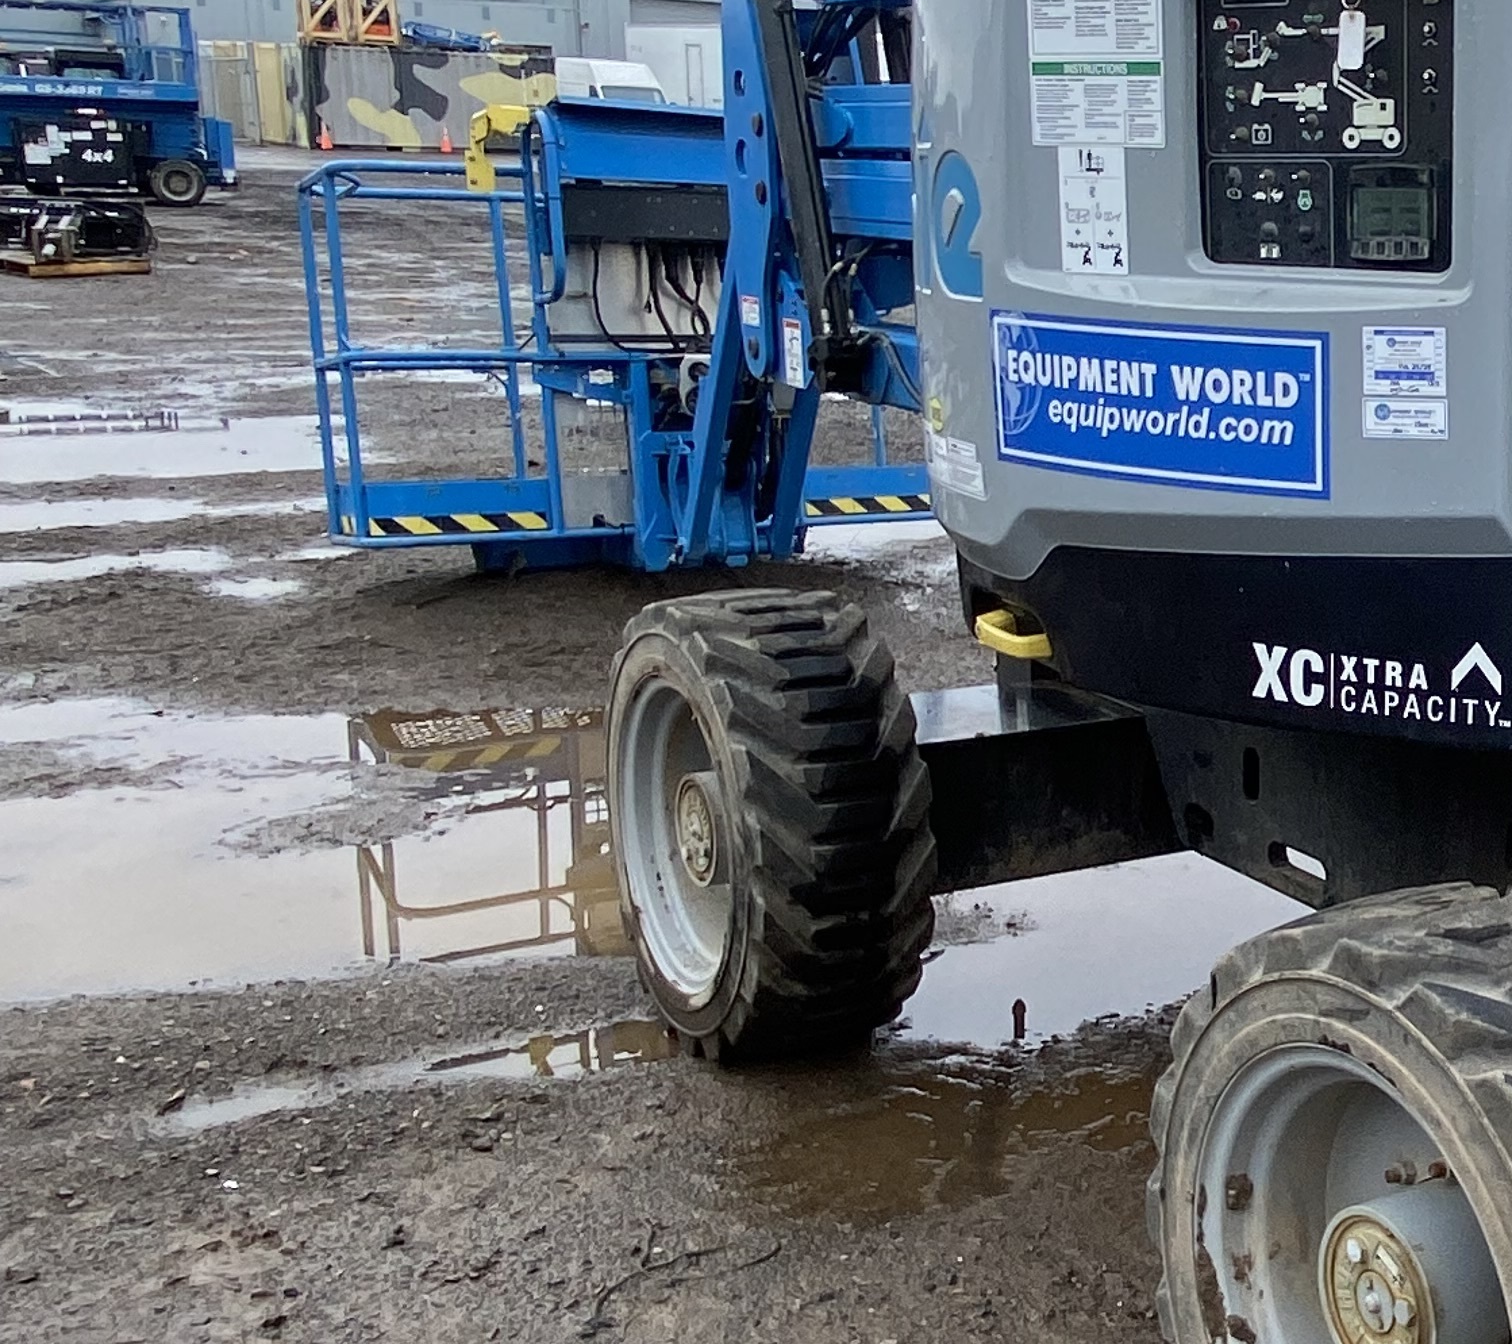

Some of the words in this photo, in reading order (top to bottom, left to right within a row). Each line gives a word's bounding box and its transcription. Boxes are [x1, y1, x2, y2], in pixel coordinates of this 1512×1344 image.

[1063, 63, 1128, 75] INSTRUCTIONS
[81, 149, 114, 163] 4x4
[1007, 349, 1157, 398] EQUIPMENT
[1170, 364, 1299, 408] WORLD
[1049, 398, 1294, 446] equipworld.com
[1252, 642, 1324, 706] XC
[1340, 655, 1428, 690] XTRA
[1340, 686, 1501, 726] CAPACITY
